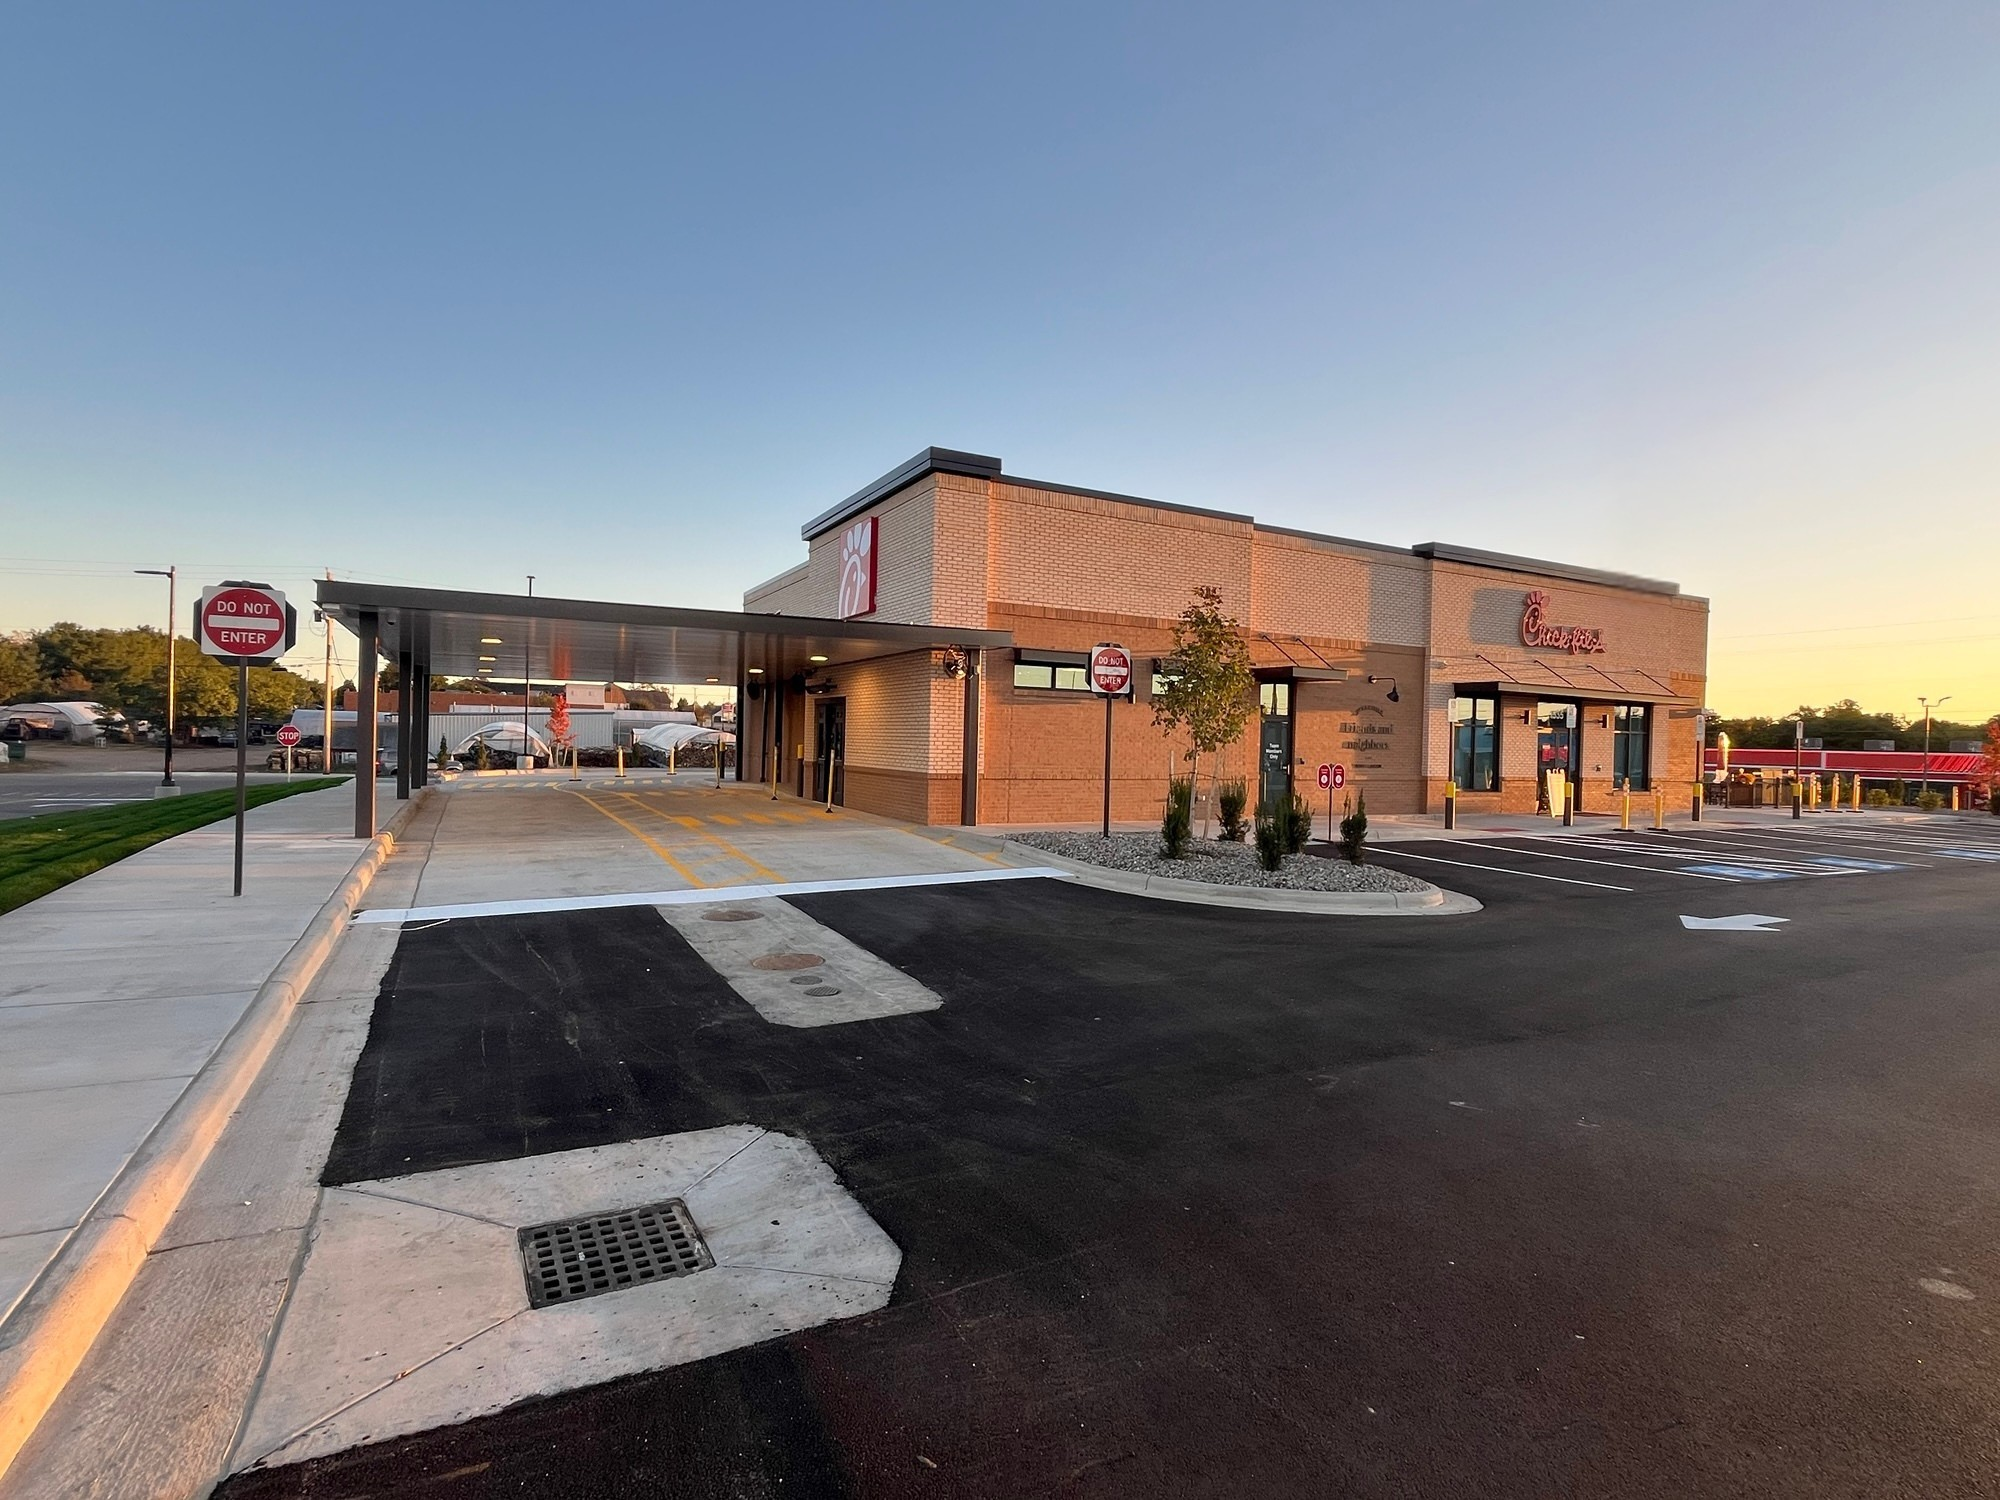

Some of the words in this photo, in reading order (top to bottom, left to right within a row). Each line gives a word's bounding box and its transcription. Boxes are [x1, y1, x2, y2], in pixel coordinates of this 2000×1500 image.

[217, 601, 237, 613] DO
[243, 602, 271, 615] NOT
[221, 631, 266, 644] ENTER
[1098, 656, 1108, 665] DO
[1110, 657, 1123, 666] NOT
[1100, 676, 1121, 685] ENTER
[280, 732, 299, 740] STOP
